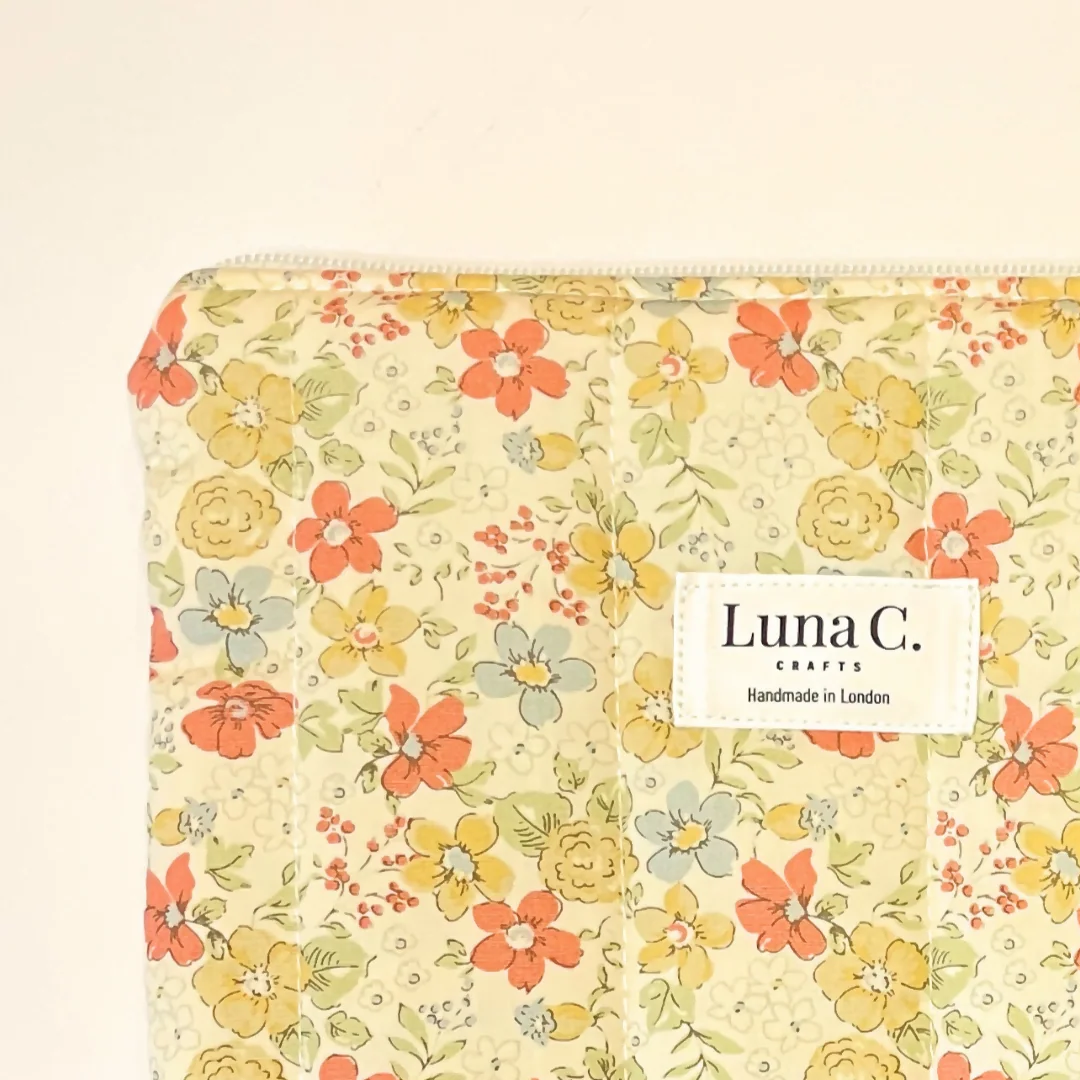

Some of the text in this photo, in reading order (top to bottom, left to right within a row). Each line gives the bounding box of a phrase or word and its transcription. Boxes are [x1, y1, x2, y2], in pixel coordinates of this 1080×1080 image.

[721, 603, 922, 652] Luna C.
[776, 660, 862, 673] CRAFTS
[747, 687, 891, 705] Handmade in London
